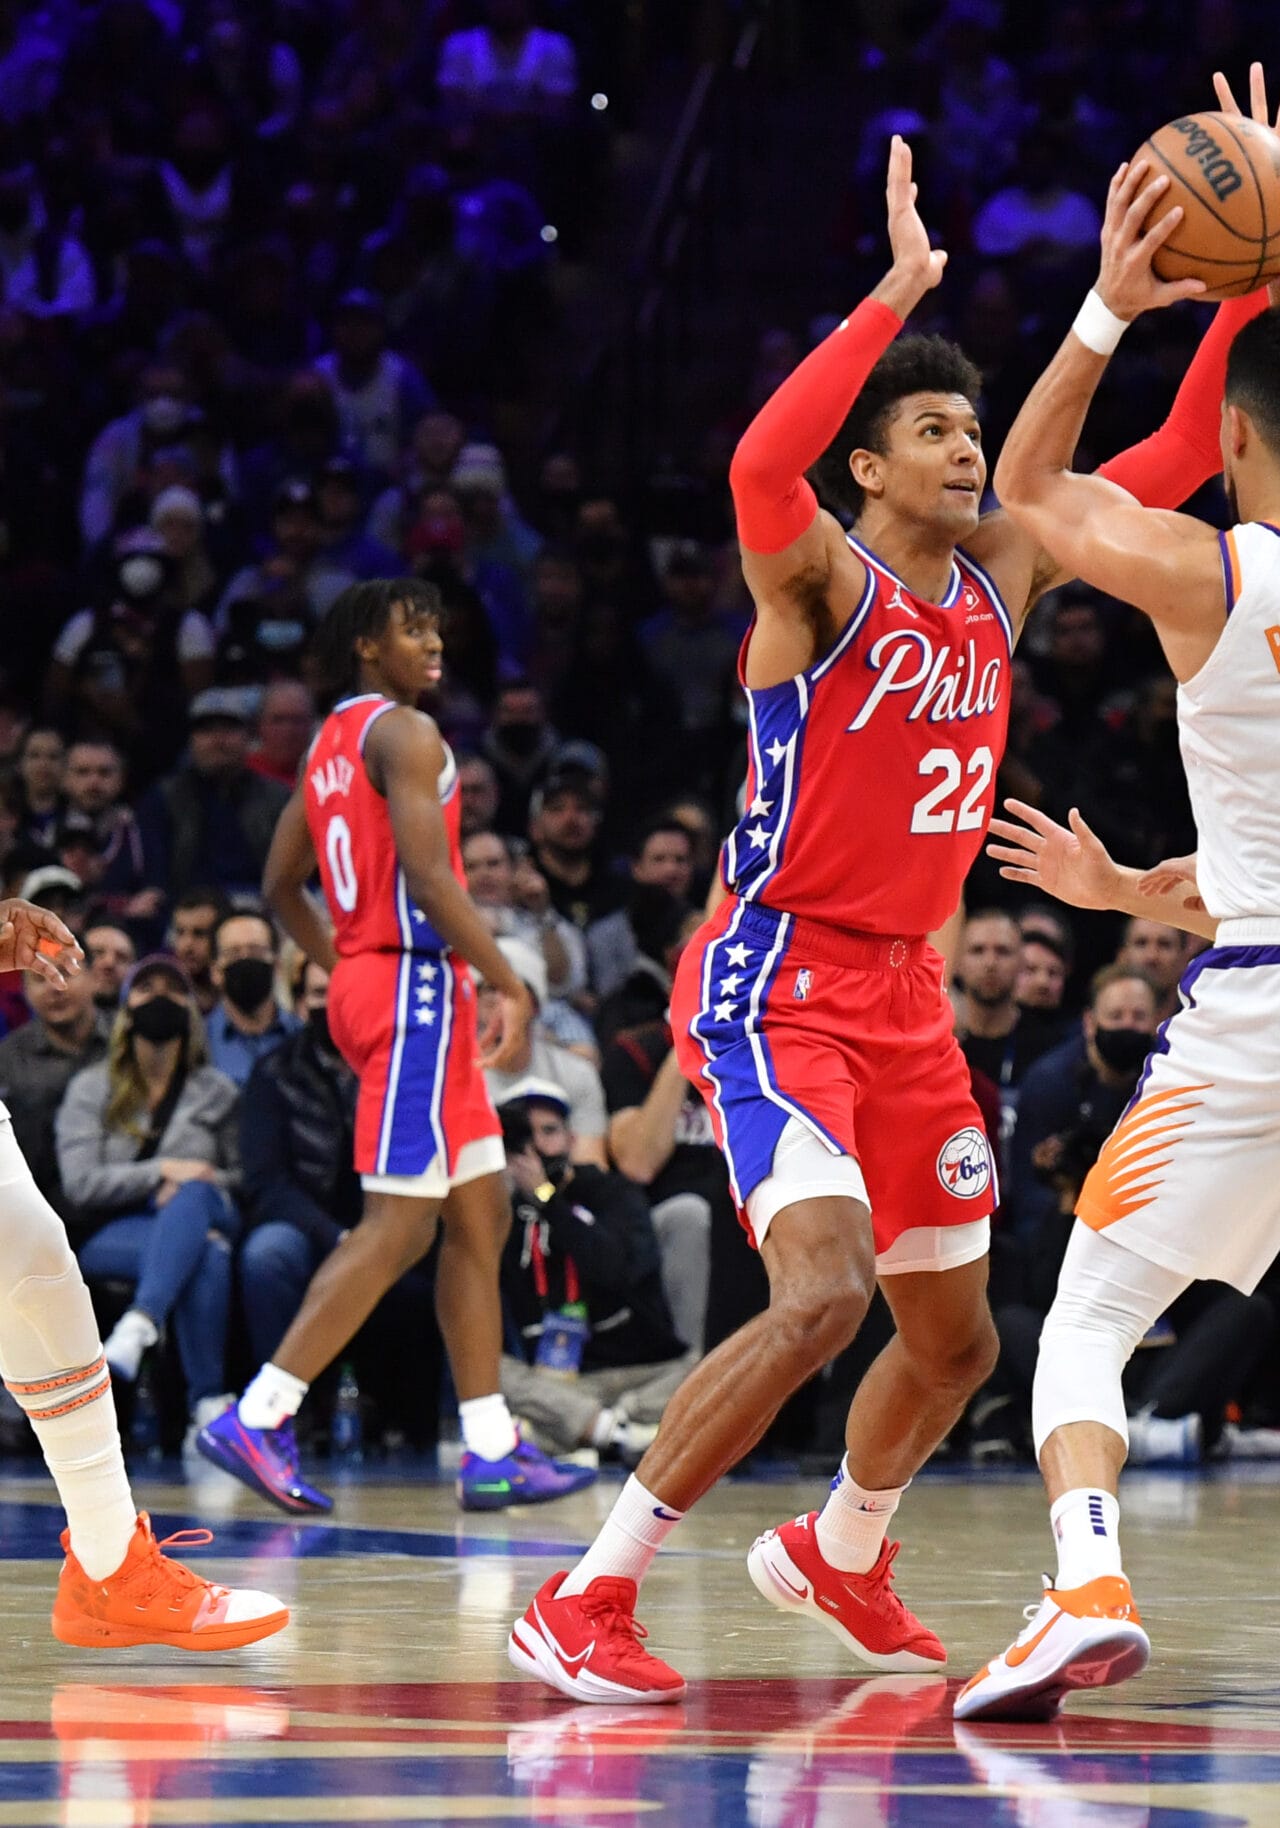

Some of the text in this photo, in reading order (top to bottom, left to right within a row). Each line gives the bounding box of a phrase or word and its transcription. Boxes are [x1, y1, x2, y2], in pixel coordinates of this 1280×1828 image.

[844, 628, 1001, 733] Phila
[910, 746, 993, 834] 22
[326, 815, 358, 912] 0
